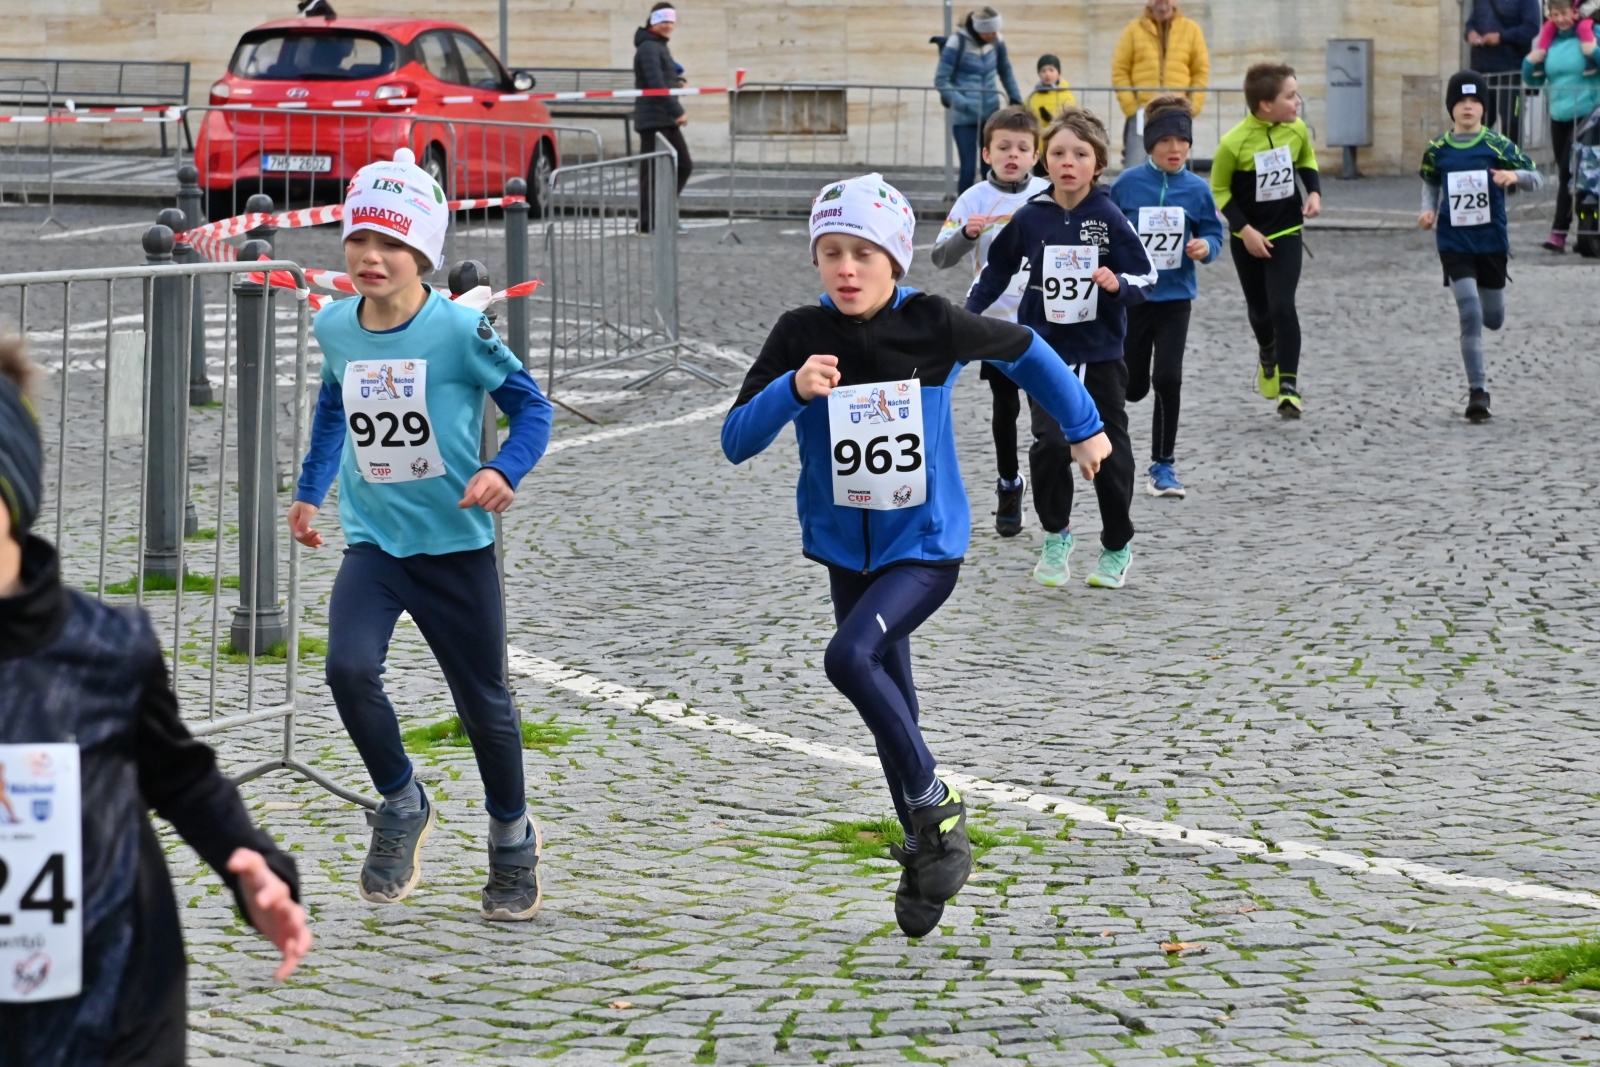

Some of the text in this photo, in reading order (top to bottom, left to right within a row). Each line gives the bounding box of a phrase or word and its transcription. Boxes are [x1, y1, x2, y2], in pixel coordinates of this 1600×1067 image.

[372, 179, 405, 194] LES
[1257, 167, 1292, 189] 722
[1450, 192, 1488, 210] 728
[352, 206, 413, 228] MARATON
[1081, 219, 1098, 229] REAL
[1139, 232, 1183, 251] 727
[1044, 276, 1096, 301] 937
[393, 376, 415, 384] Náchod
[887, 398, 911, 407] Náchod
[349, 411, 430, 447] 929
[833, 433, 922, 476] 963
[371, 467, 392, 476] CUP
[847, 494, 872, 502] CUP
